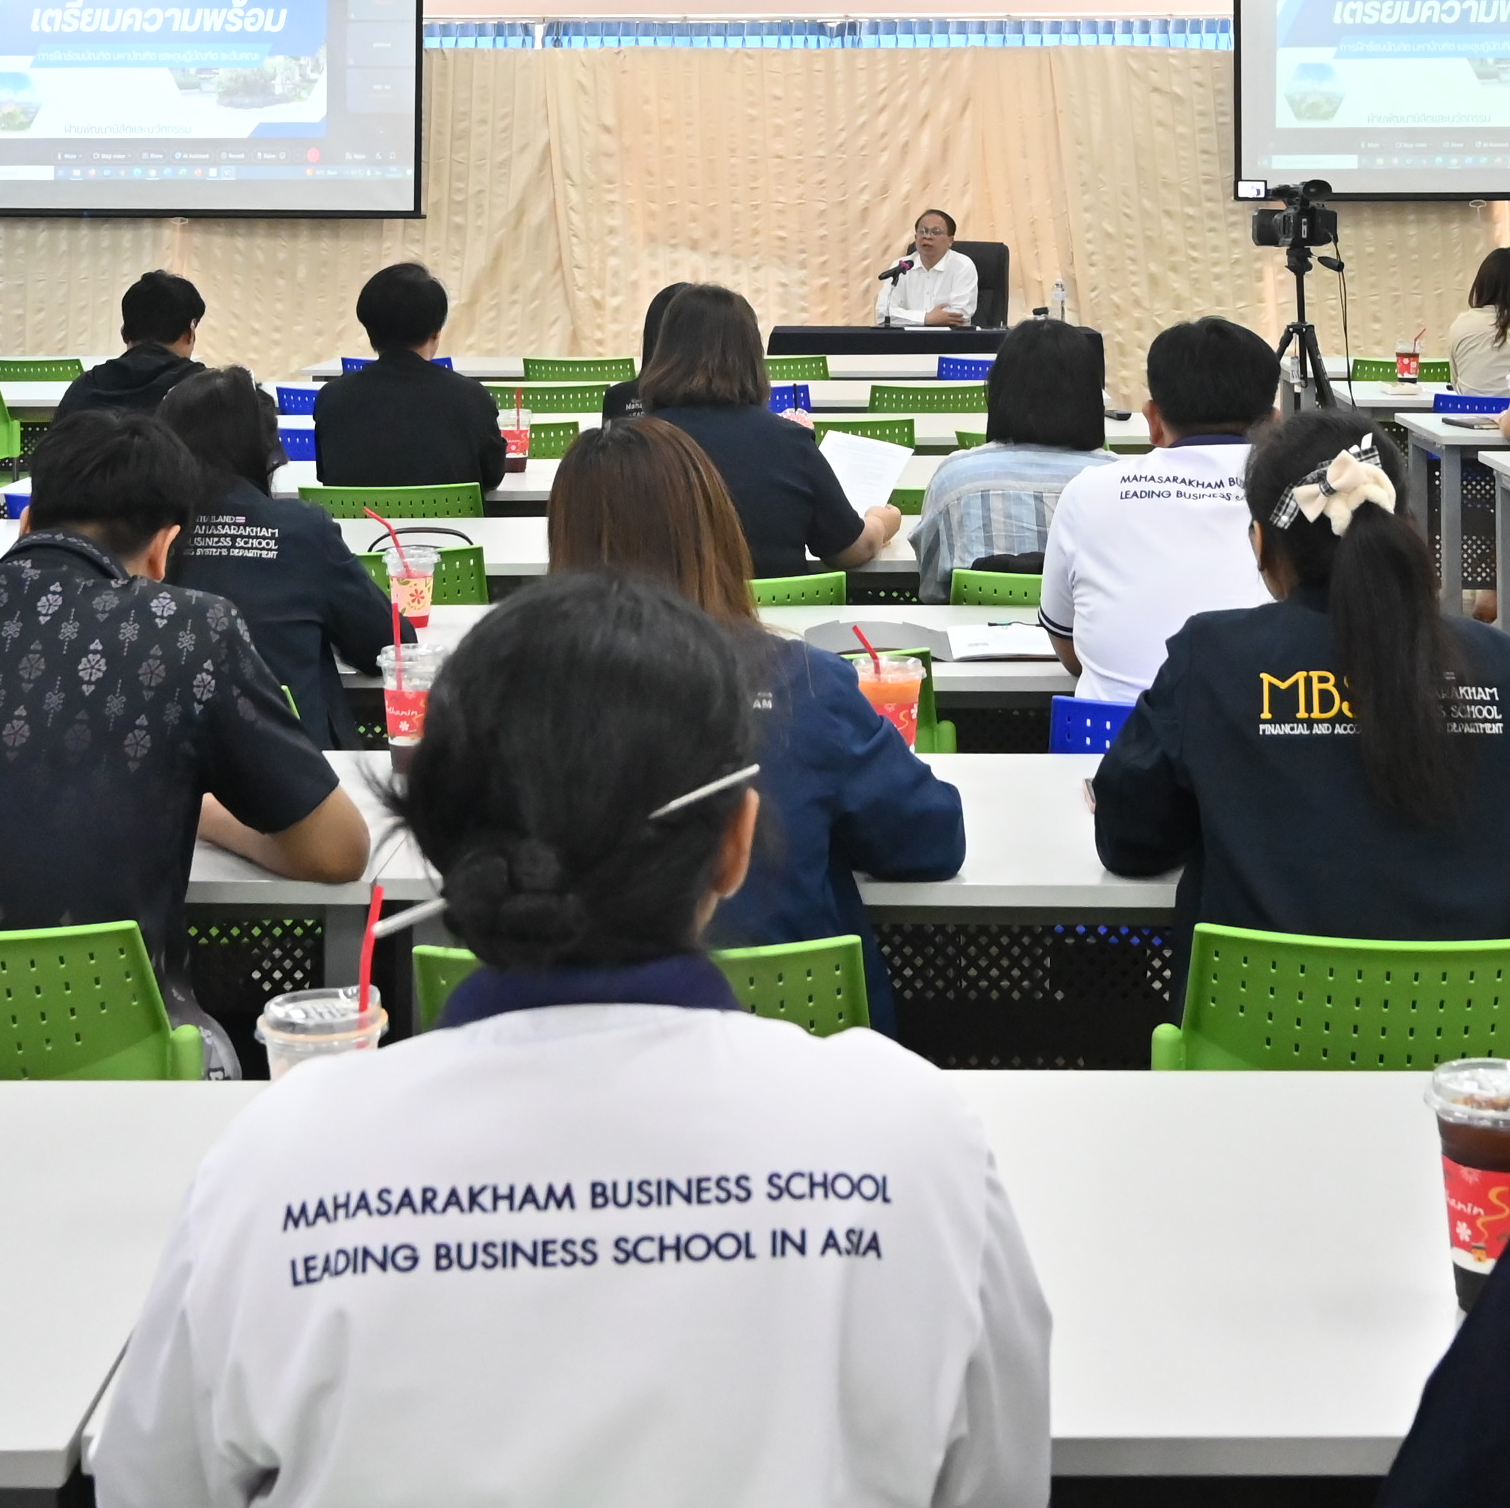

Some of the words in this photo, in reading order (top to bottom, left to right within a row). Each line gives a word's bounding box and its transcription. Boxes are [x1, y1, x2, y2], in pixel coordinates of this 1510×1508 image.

[1120, 474, 1225, 490] MAHASARAKHAM
[1120, 490, 1172, 500] LEADING
[194, 525, 279, 538] AHASARAKHAM
[189, 537, 233, 547] USINESS
[235, 538, 279, 550] SCHOOL
[196, 548, 229, 556] SYSTEMS
[230, 548, 279, 559] DEPARTMENT
[1450, 705, 1503, 719] SCHOOL
[1259, 723, 1311, 735] FINANCIAL
[1312, 723, 1332, 734] AND
[1446, 722, 1503, 734] DEPARTMENT
[282, 1182, 576, 1231] MAHASARAKHAM
[590, 1174, 753, 1212] BUSINESS
[766, 1172, 893, 1204] SCHOOL
[290, 1243, 420, 1287] LEADING
[434, 1238, 598, 1272] BUSINESS
[612, 1232, 756, 1265] SCHOOL
[771, 1229, 808, 1259] IN
[820, 1227, 883, 1259] ASIA
